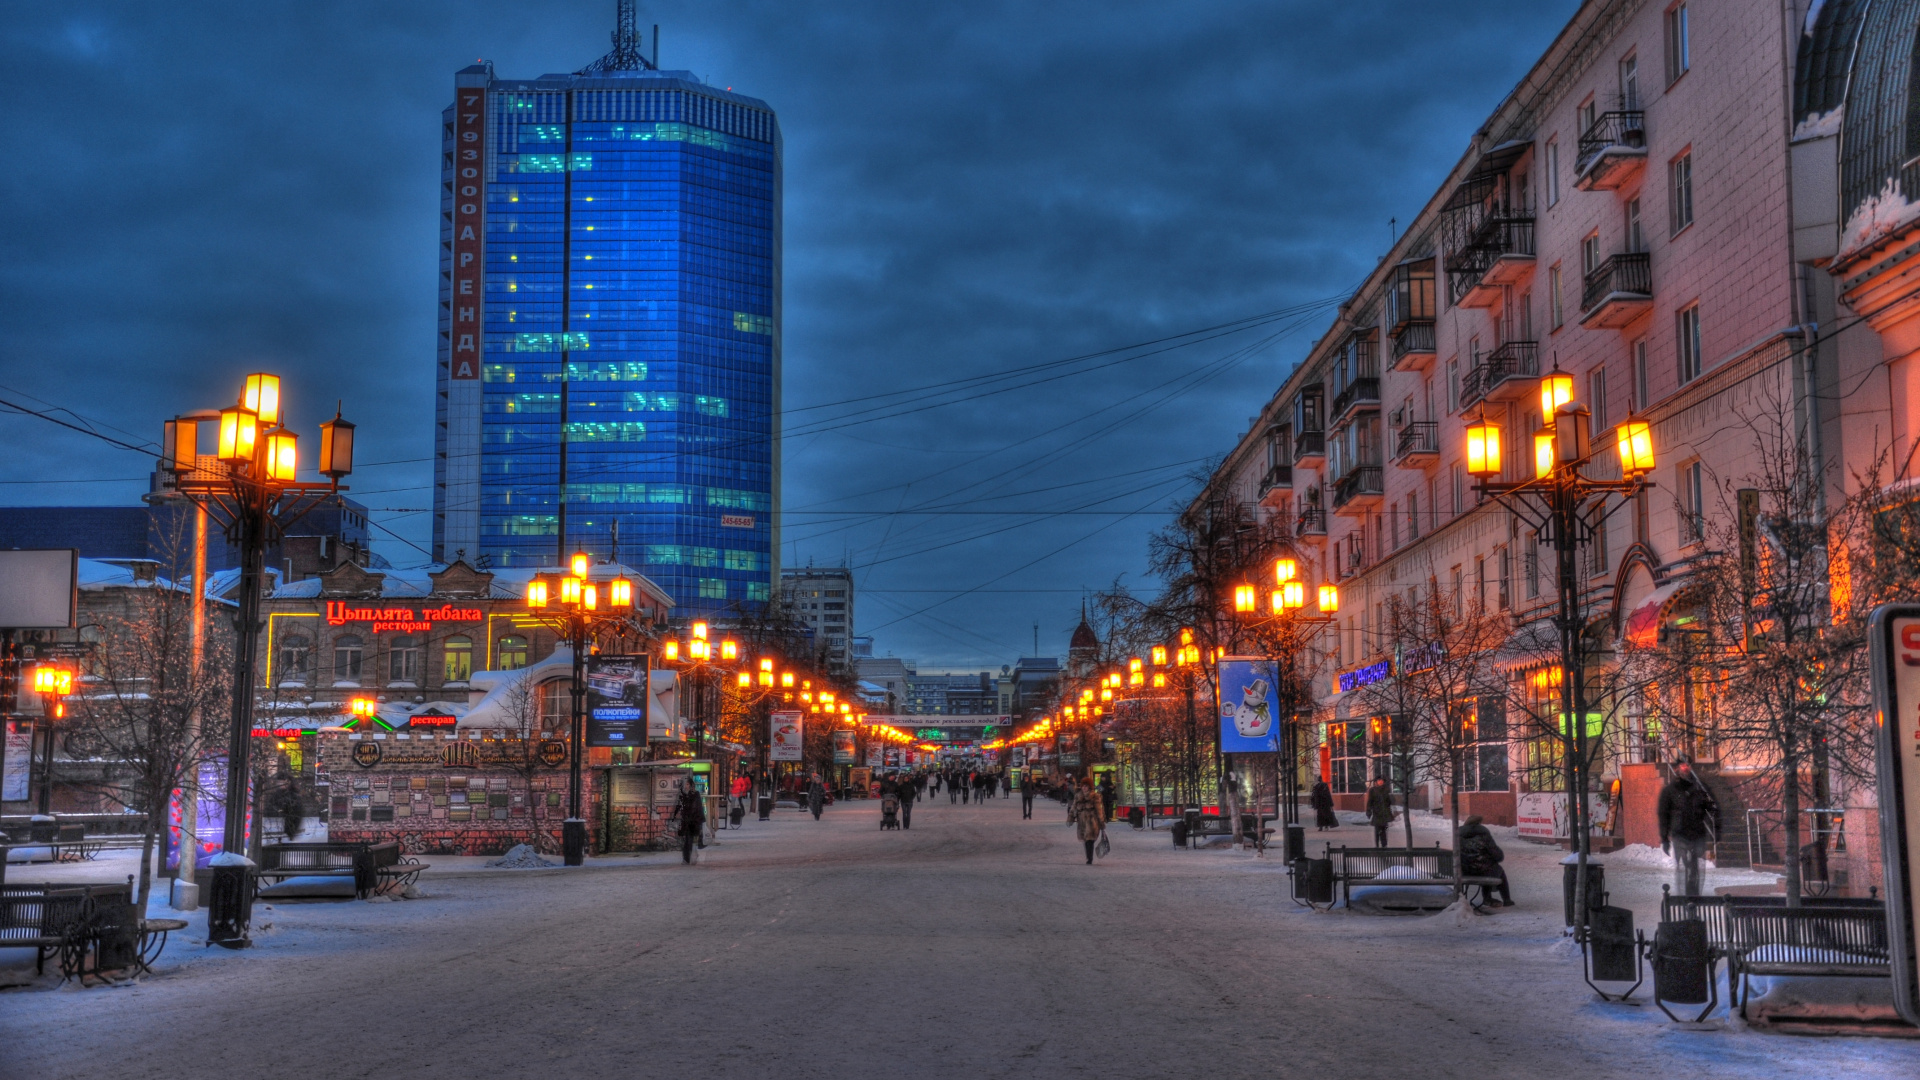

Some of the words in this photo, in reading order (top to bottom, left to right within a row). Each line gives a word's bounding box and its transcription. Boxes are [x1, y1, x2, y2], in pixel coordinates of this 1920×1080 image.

[461, 95, 479, 215] 7793000
[457, 225, 476, 377] АРЕНДА
[722, 517, 750, 526] 245-65-65
[326, 600, 414, 626] Цыплята
[422, 604, 482, 621] табака
[373, 621, 431, 633] ресторан
[593, 708, 641, 716] ПОЛКОПЕЙКИ
[410, 716, 455, 726] ресторан
[942, 717, 976, 725] рекламной
